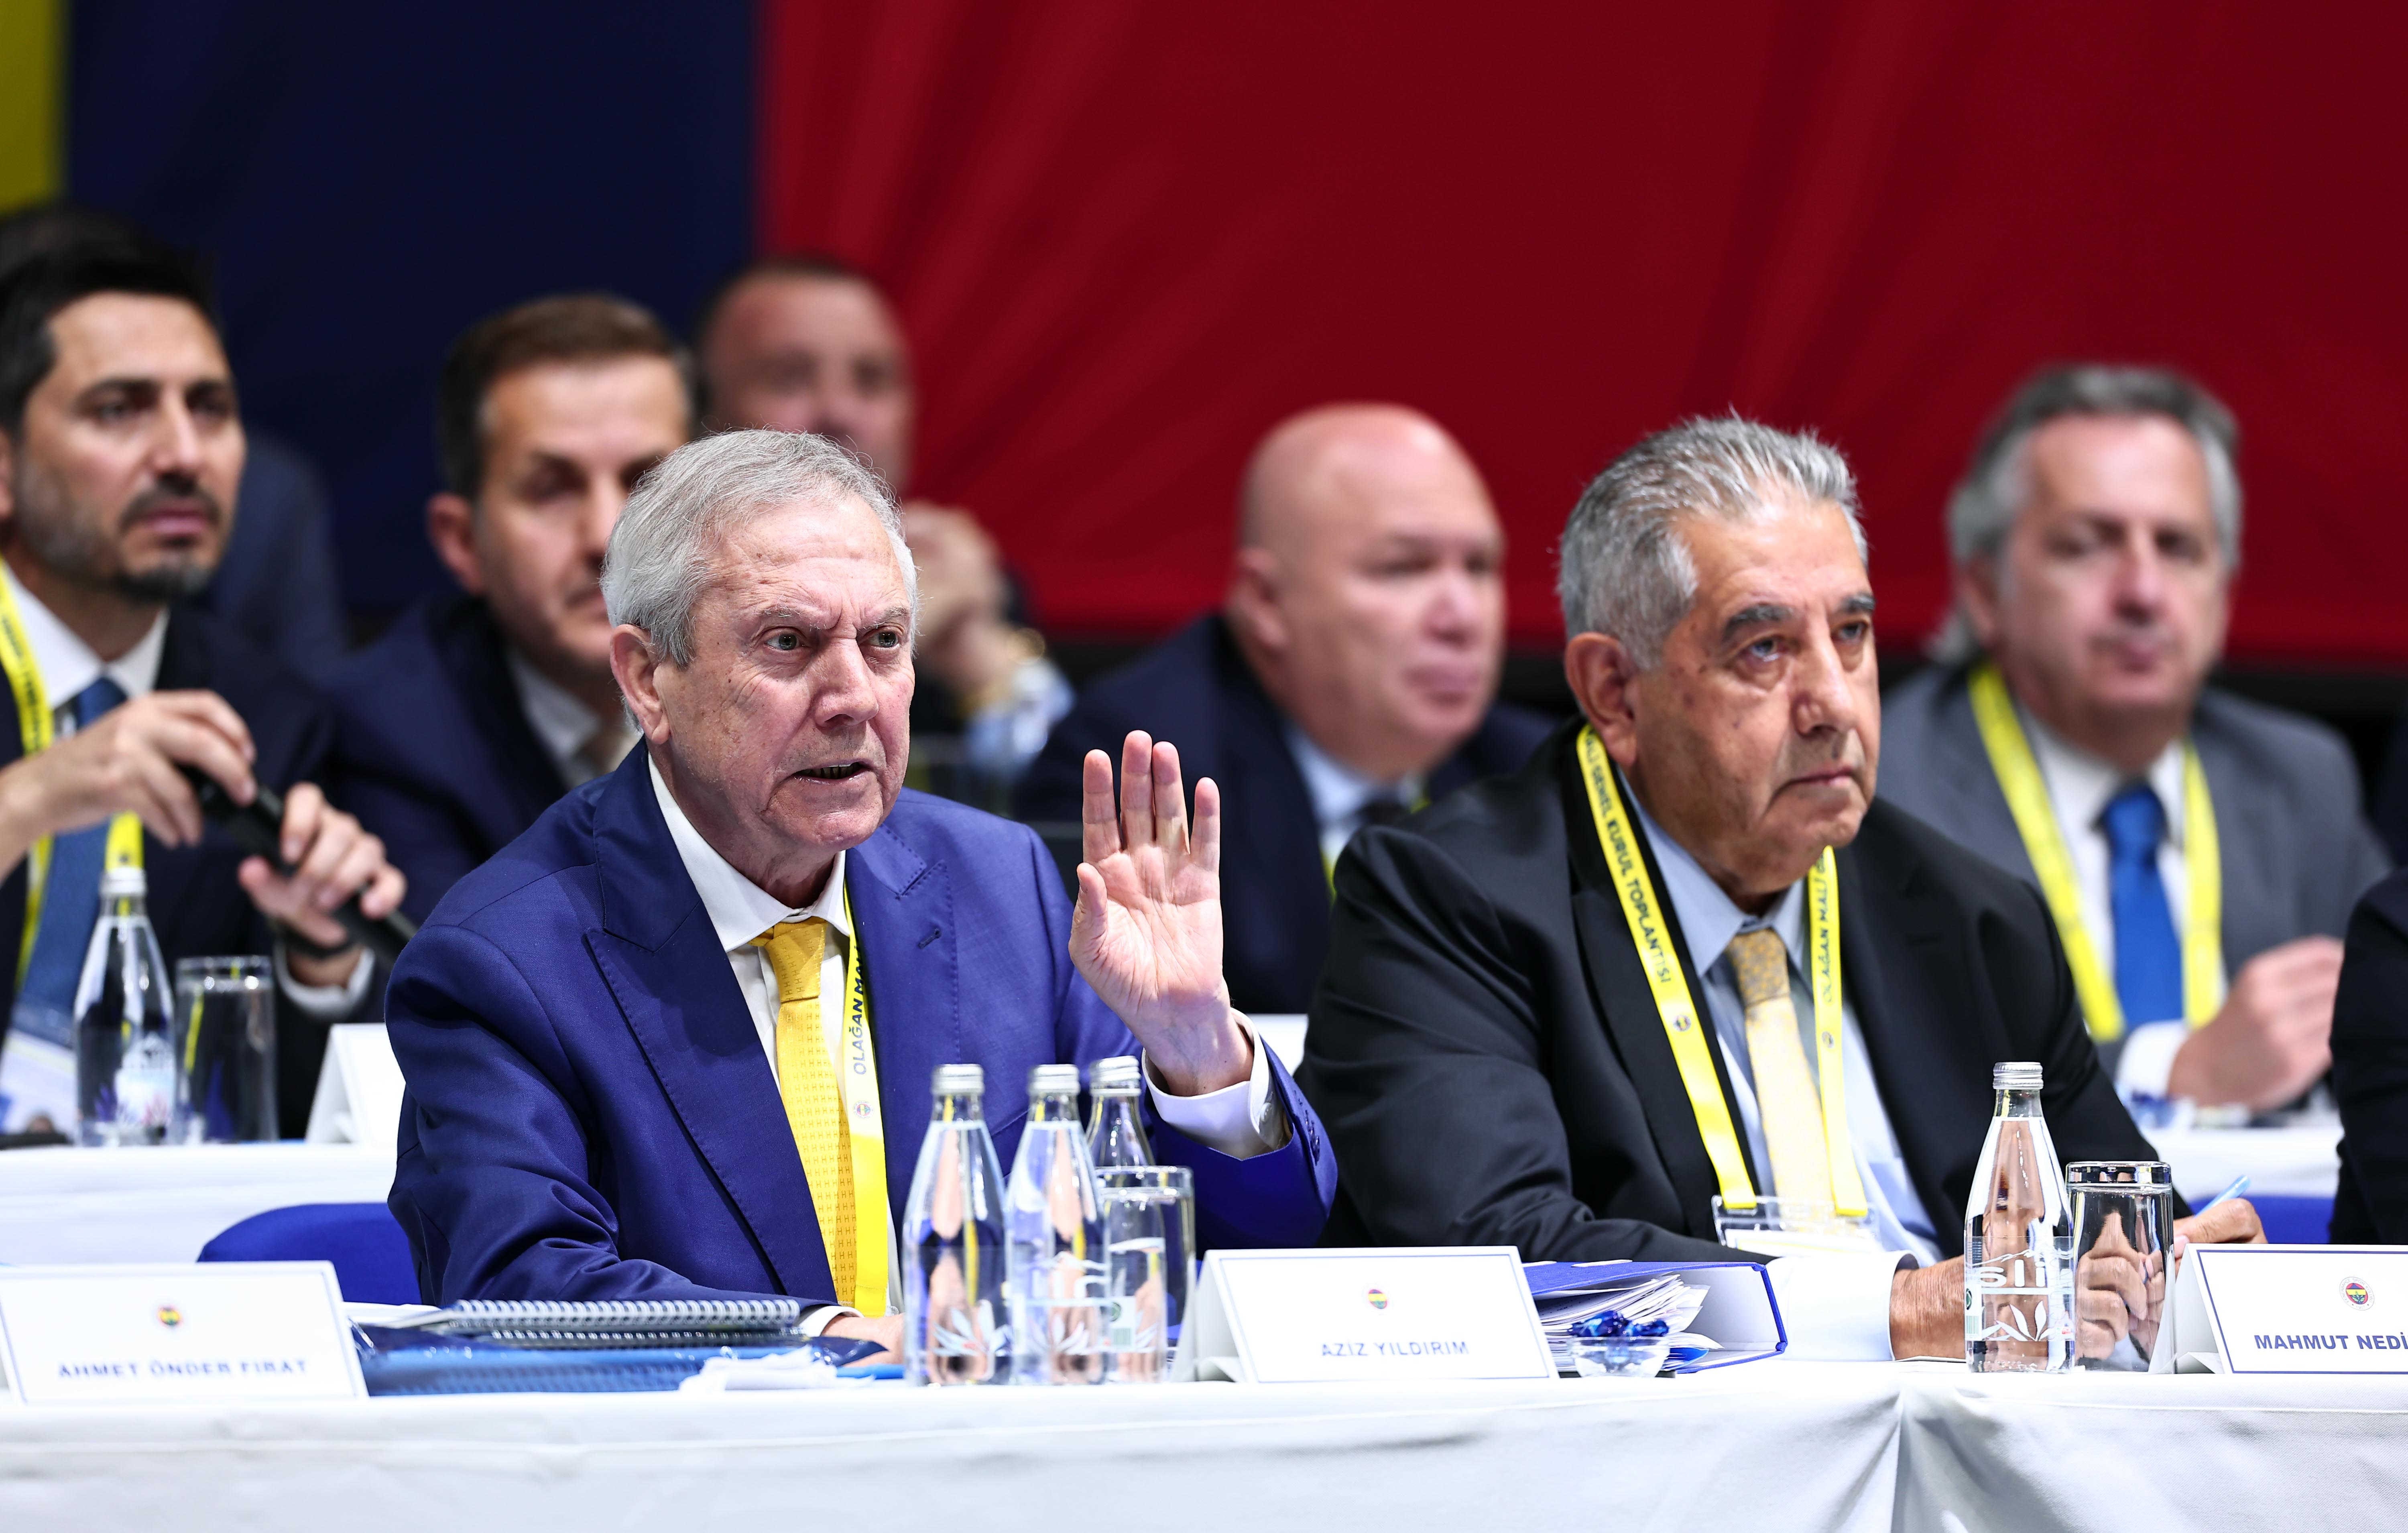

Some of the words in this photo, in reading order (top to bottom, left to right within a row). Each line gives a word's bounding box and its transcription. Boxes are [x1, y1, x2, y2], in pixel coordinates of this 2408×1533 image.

[1607, 819, 1633, 876] KURUL
[849, 998, 866, 1075] OLAĞAN
[1373, 1341, 1469, 1356] YILDIRIM
[2254, 1335, 2348, 1349] MAHMUT
[2356, 1332, 2408, 1349] NEDİ
[59, 1362, 137, 1378] AHMET
